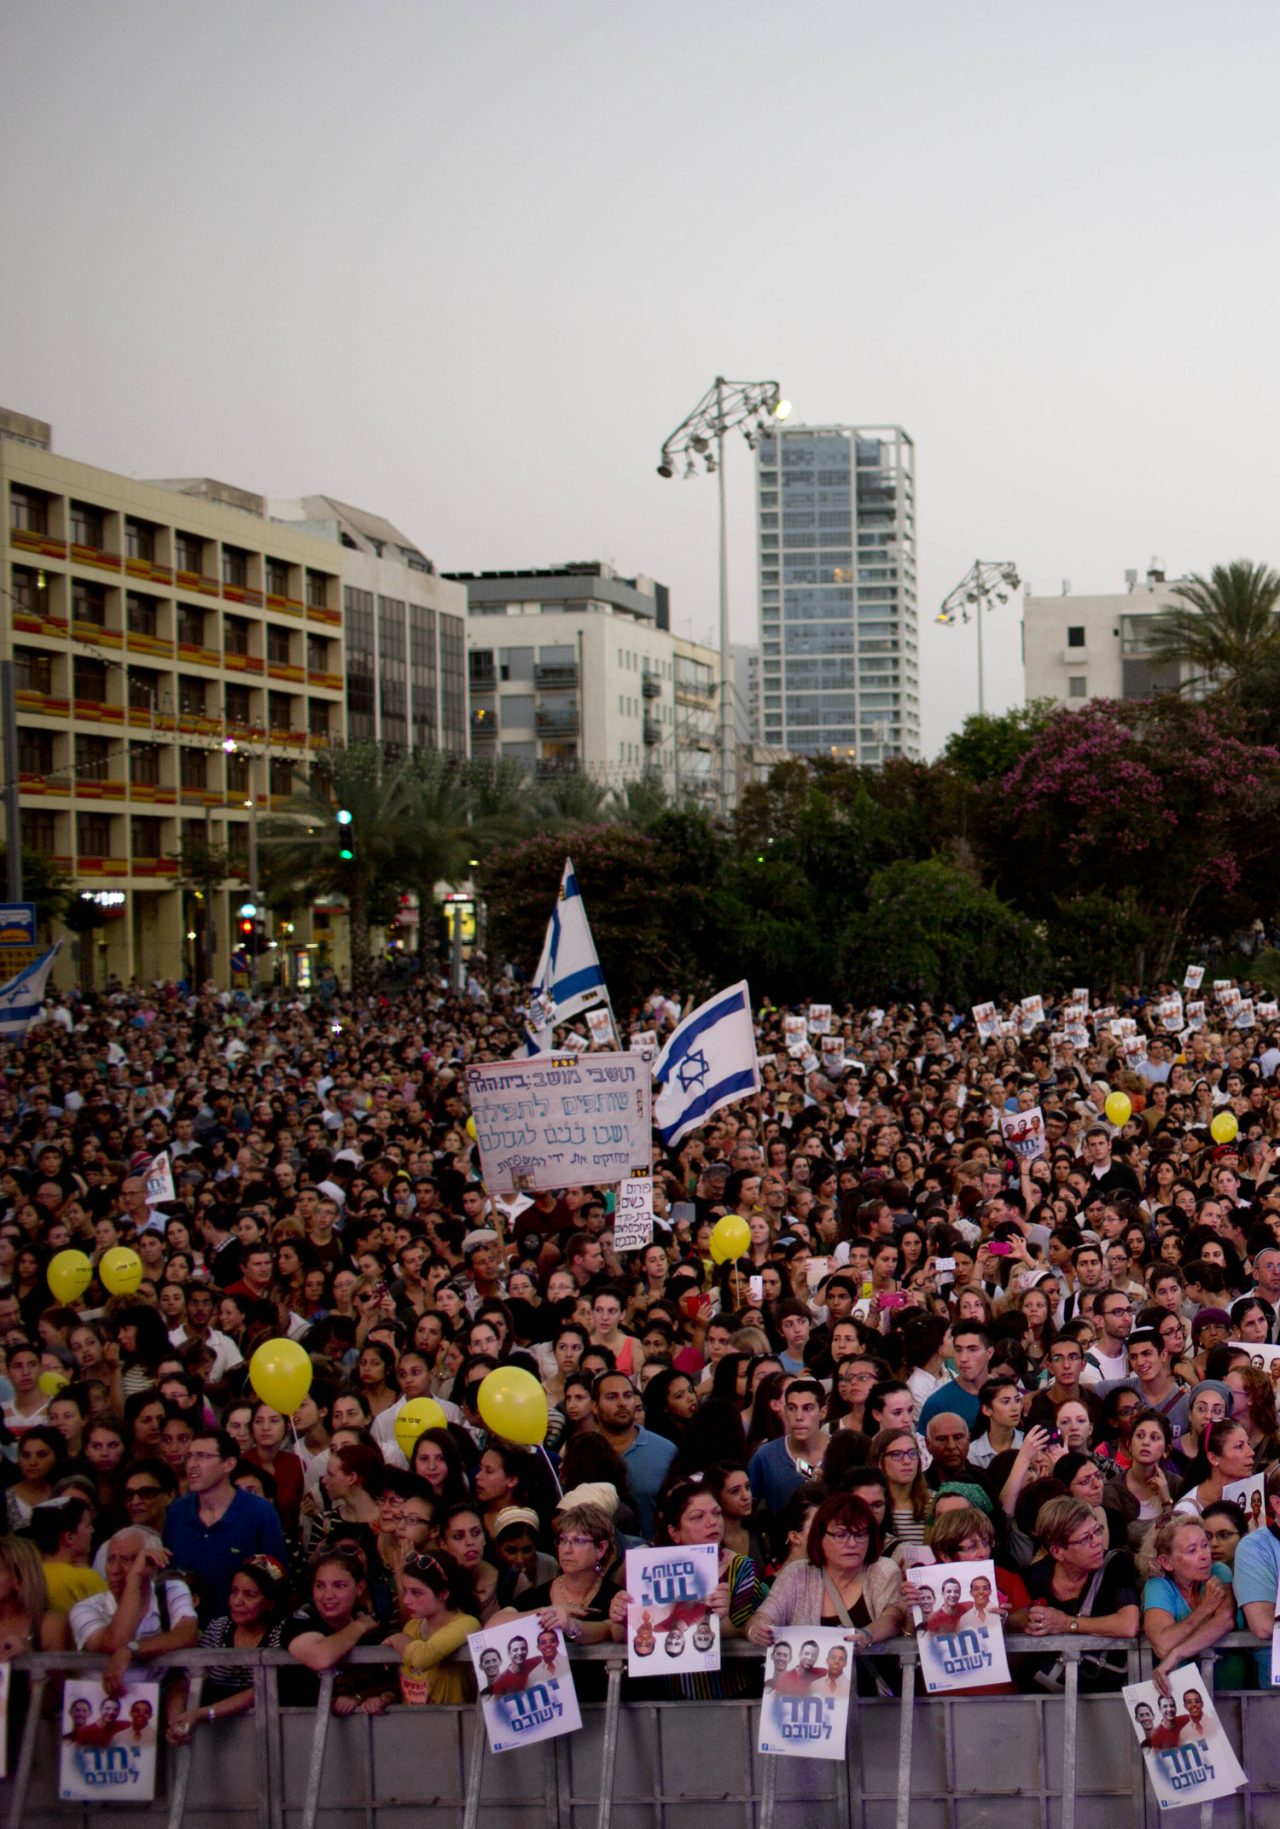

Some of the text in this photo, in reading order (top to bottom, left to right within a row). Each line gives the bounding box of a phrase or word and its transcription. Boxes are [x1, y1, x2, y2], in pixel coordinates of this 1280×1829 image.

[570, 1152, 587, 1165] את
[937, 1625, 990, 1659] יחד
[944, 1650, 992, 1675] לשובם
[503, 1677, 560, 1716] יחד
[782, 1696, 834, 1723] יחד
[512, 1701, 563, 1732] לשובם
[781, 1721, 833, 1740] לשובם
[83, 1746, 141, 1770] יחד
[1161, 1738, 1209, 1773] יחד
[84, 1767, 140, 1785] לשובם
[1170, 1762, 1215, 1791] לשובם
